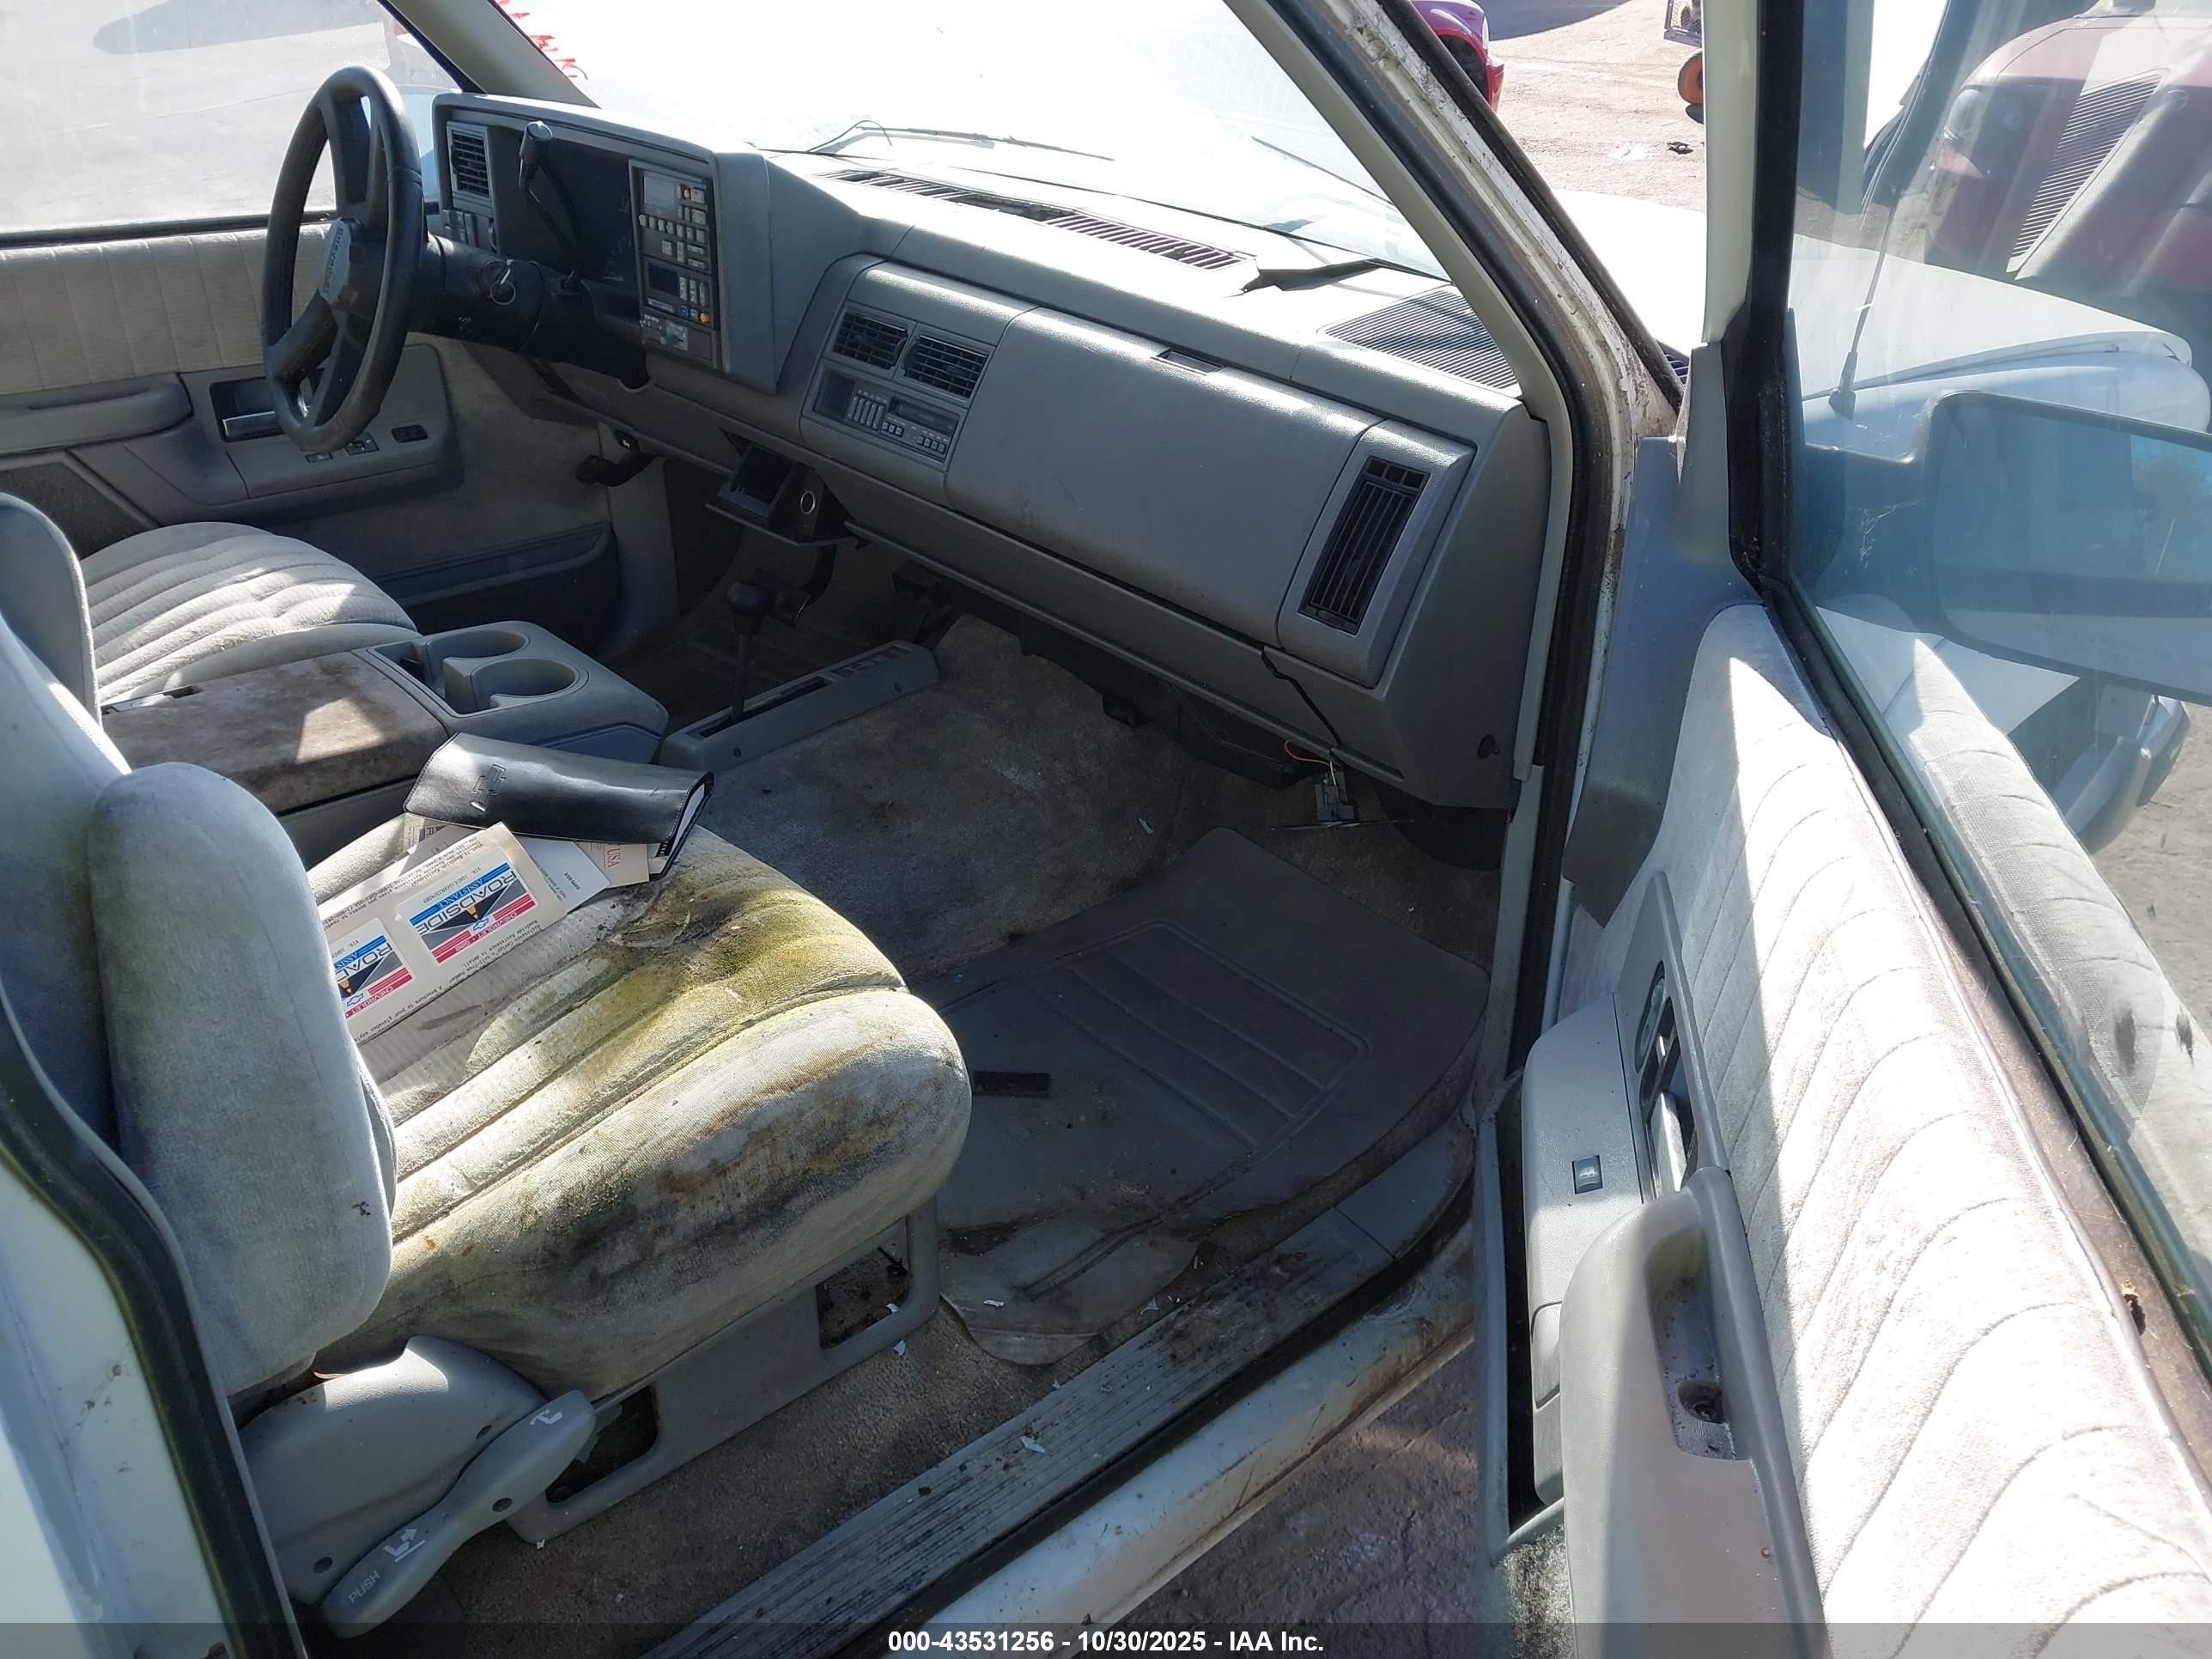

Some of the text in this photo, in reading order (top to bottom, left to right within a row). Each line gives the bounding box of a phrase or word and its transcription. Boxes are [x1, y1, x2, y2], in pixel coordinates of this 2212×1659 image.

[415, 870, 518, 936] ROADSIDE
[436, 878, 484, 909] ASSISTANCE
[477, 911, 518, 939] CHEVROLET
[350, 986, 393, 1013] CHEVROLET
[347, 1570, 380, 1603] PUSH
